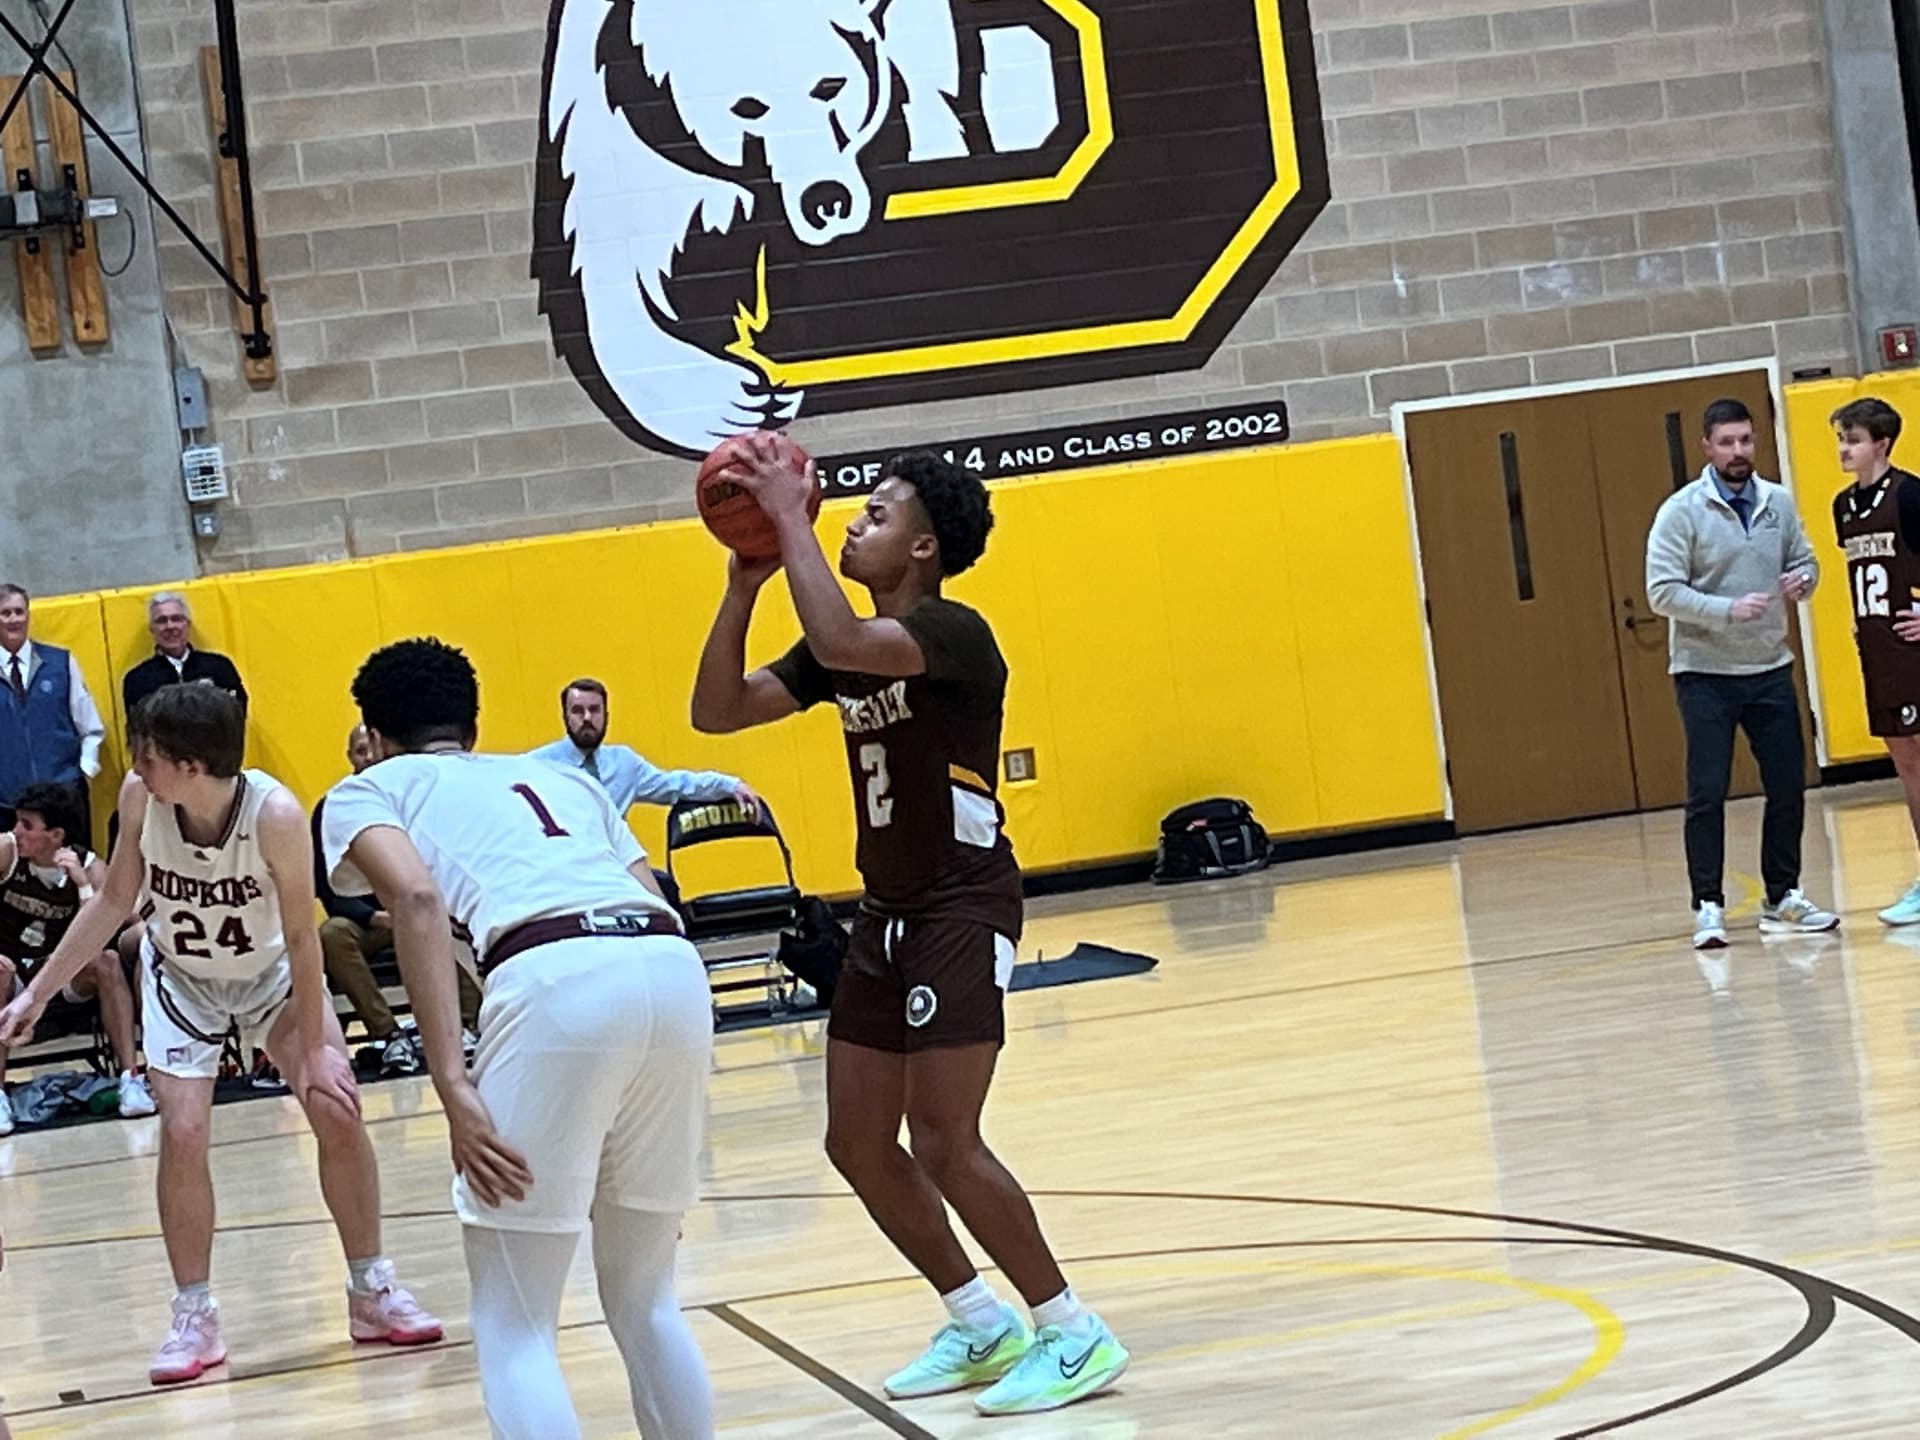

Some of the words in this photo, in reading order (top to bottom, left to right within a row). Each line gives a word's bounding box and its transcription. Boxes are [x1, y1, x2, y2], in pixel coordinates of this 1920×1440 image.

[837, 463, 882, 487] OF
[1206, 412, 1282, 441] 2002
[1855, 563, 1889, 617] 12
[511, 784, 569, 837] 1
[859, 742, 894, 828] 2
[678, 803, 757, 834] BRUIN
[150, 863, 262, 908] HOPKINS
[171, 910, 254, 959] 24
